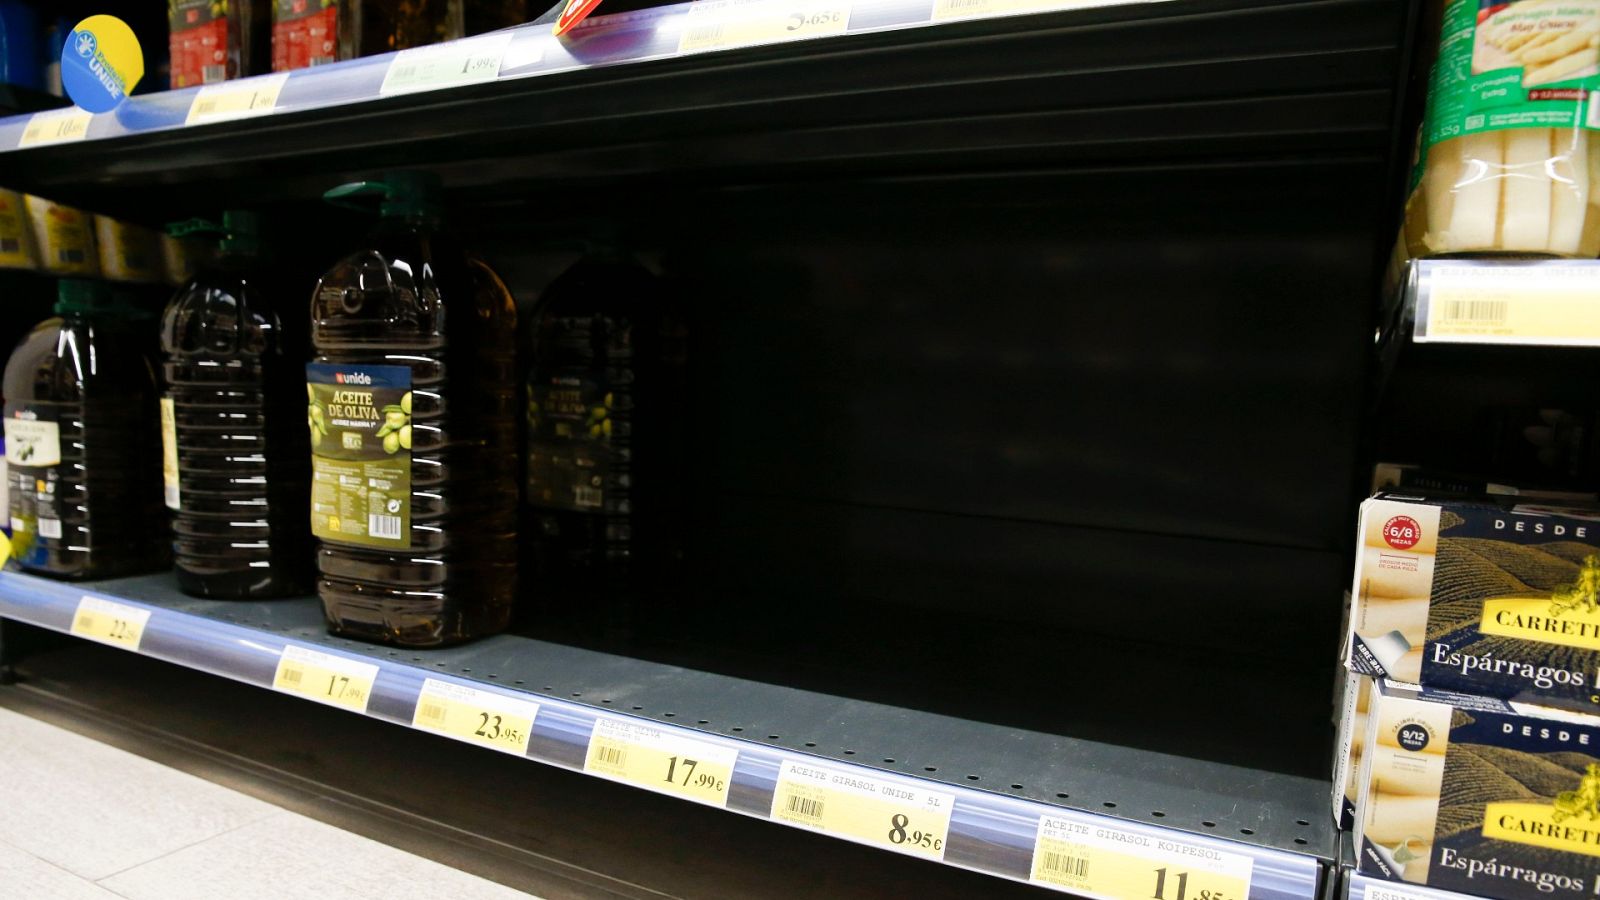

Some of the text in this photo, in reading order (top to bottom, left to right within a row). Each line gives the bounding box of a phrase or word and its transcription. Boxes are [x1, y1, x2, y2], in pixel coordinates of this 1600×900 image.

[89, 56, 119, 100] UNIDE
[343, 372, 371, 385] unide
[333, 390, 373, 406] ACEITE
[328, 404, 380, 420] DE OLIVA
[1390, 526, 1413, 539] 6/8
[1494, 519, 1586, 538] DESDE
[1431, 642, 1585, 689] Espárragos
[1402, 730, 1425, 741] 9/12
[1502, 722, 1590, 745] DESDE
[790, 765, 827, 780] ACEITE
[832, 775, 876, 793] GIRASOL
[881, 786, 915, 801] UNIDE
[927, 797, 941, 807] 5L
[1044, 819, 1090, 835] ACEITE
[1096, 829, 1151, 847] GIRASOL
[1157, 840, 1223, 861] KOIPESOL
[1439, 847, 1584, 893] Espárragos
